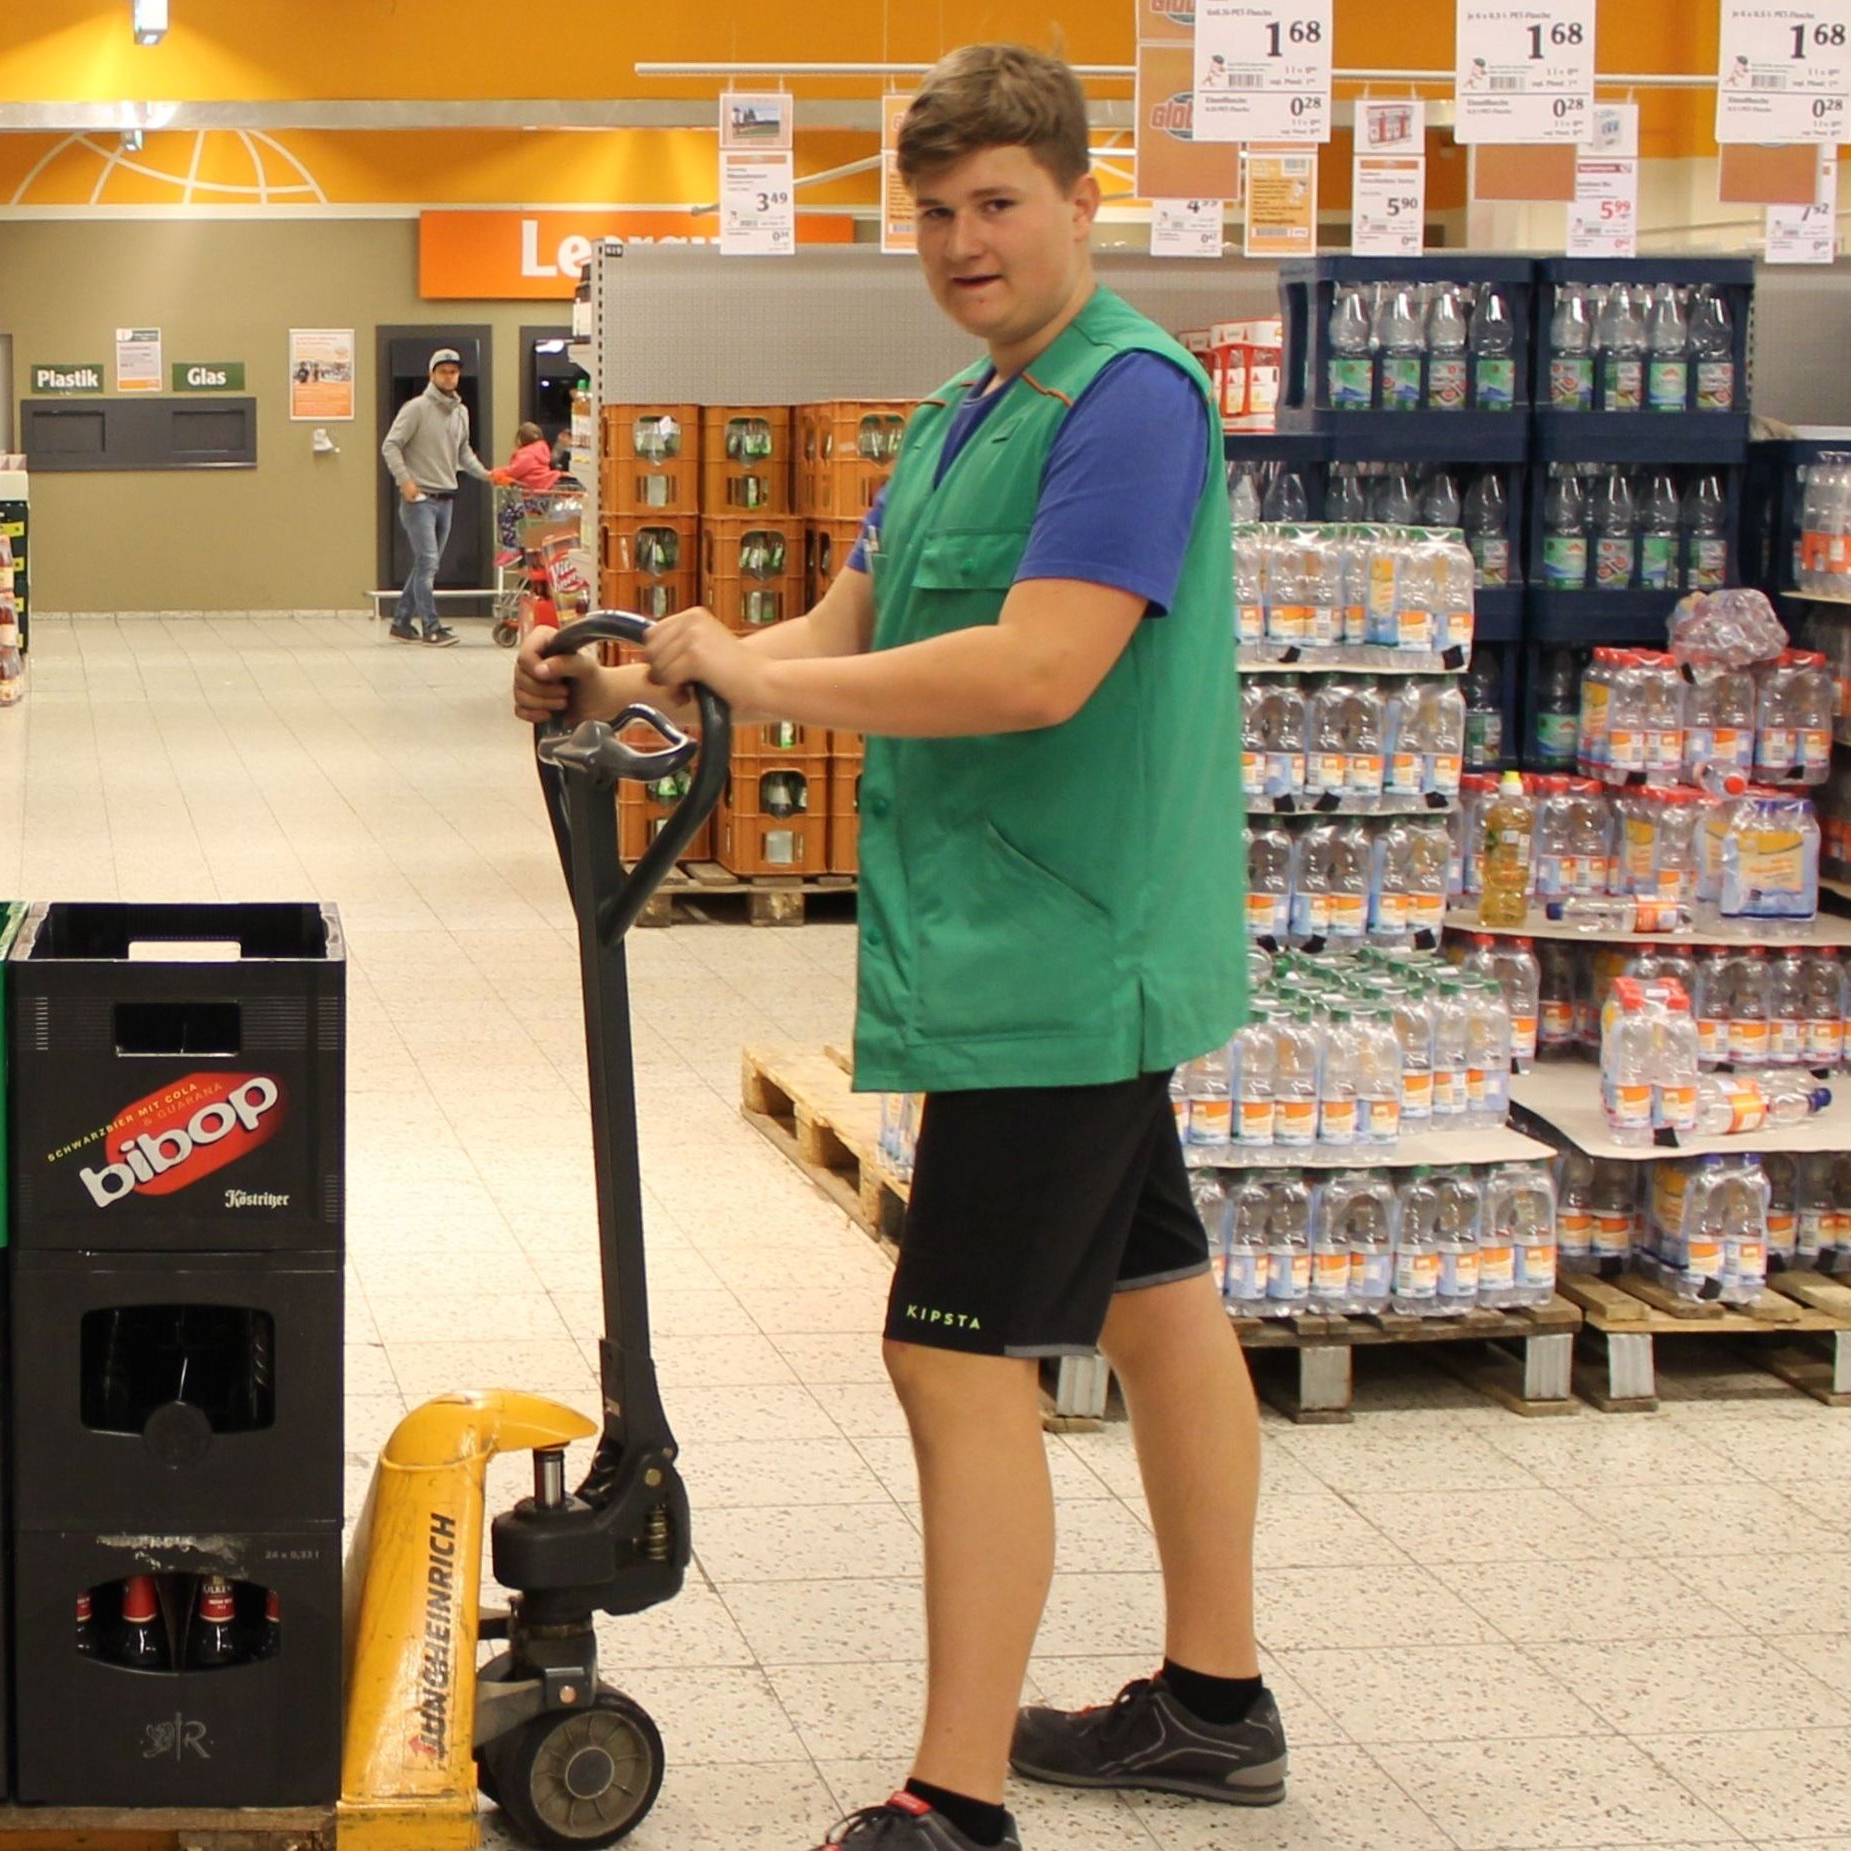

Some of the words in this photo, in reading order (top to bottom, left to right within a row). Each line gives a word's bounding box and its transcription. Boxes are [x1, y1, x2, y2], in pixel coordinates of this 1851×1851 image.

[757, 192, 789, 212] 349
[1387, 197, 1418, 216] 590
[1600, 201, 1632, 219] 599
[37, 369, 99, 388] Plastik
[187, 367, 227, 386] Glas
[158, 1082, 223, 1119] GUARANA
[47, 1113, 134, 1162] SCHWARZBIER
[138, 1101, 160, 1116] MIT
[164, 1083, 198, 1103] COLA
[79, 1077, 278, 1207] bibop
[906, 1304, 981, 1330] KIPSTA
